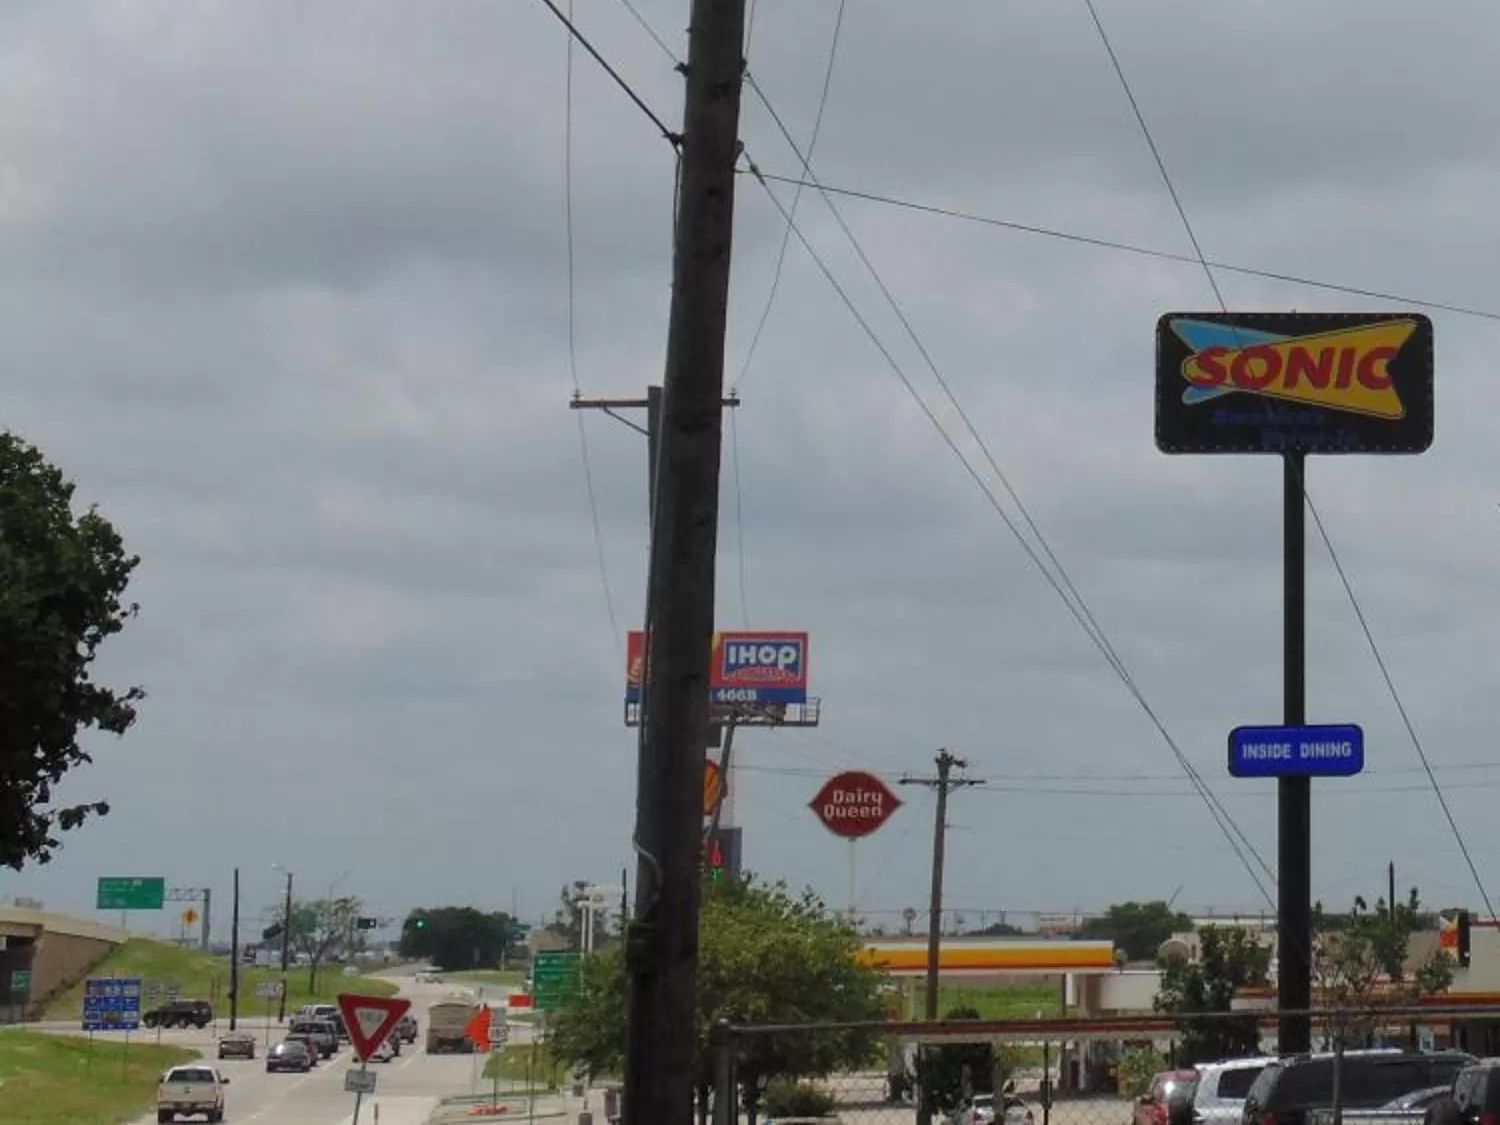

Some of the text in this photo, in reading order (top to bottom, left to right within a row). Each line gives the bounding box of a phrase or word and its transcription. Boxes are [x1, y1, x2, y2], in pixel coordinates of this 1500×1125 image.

[1186, 345, 1400, 389] SONIC
[728, 644, 797, 670] IHOP
[1242, 740, 1352, 760] INSIDE DINING
[832, 786, 883, 807] Dairy
[823, 803, 881, 821] Queen
